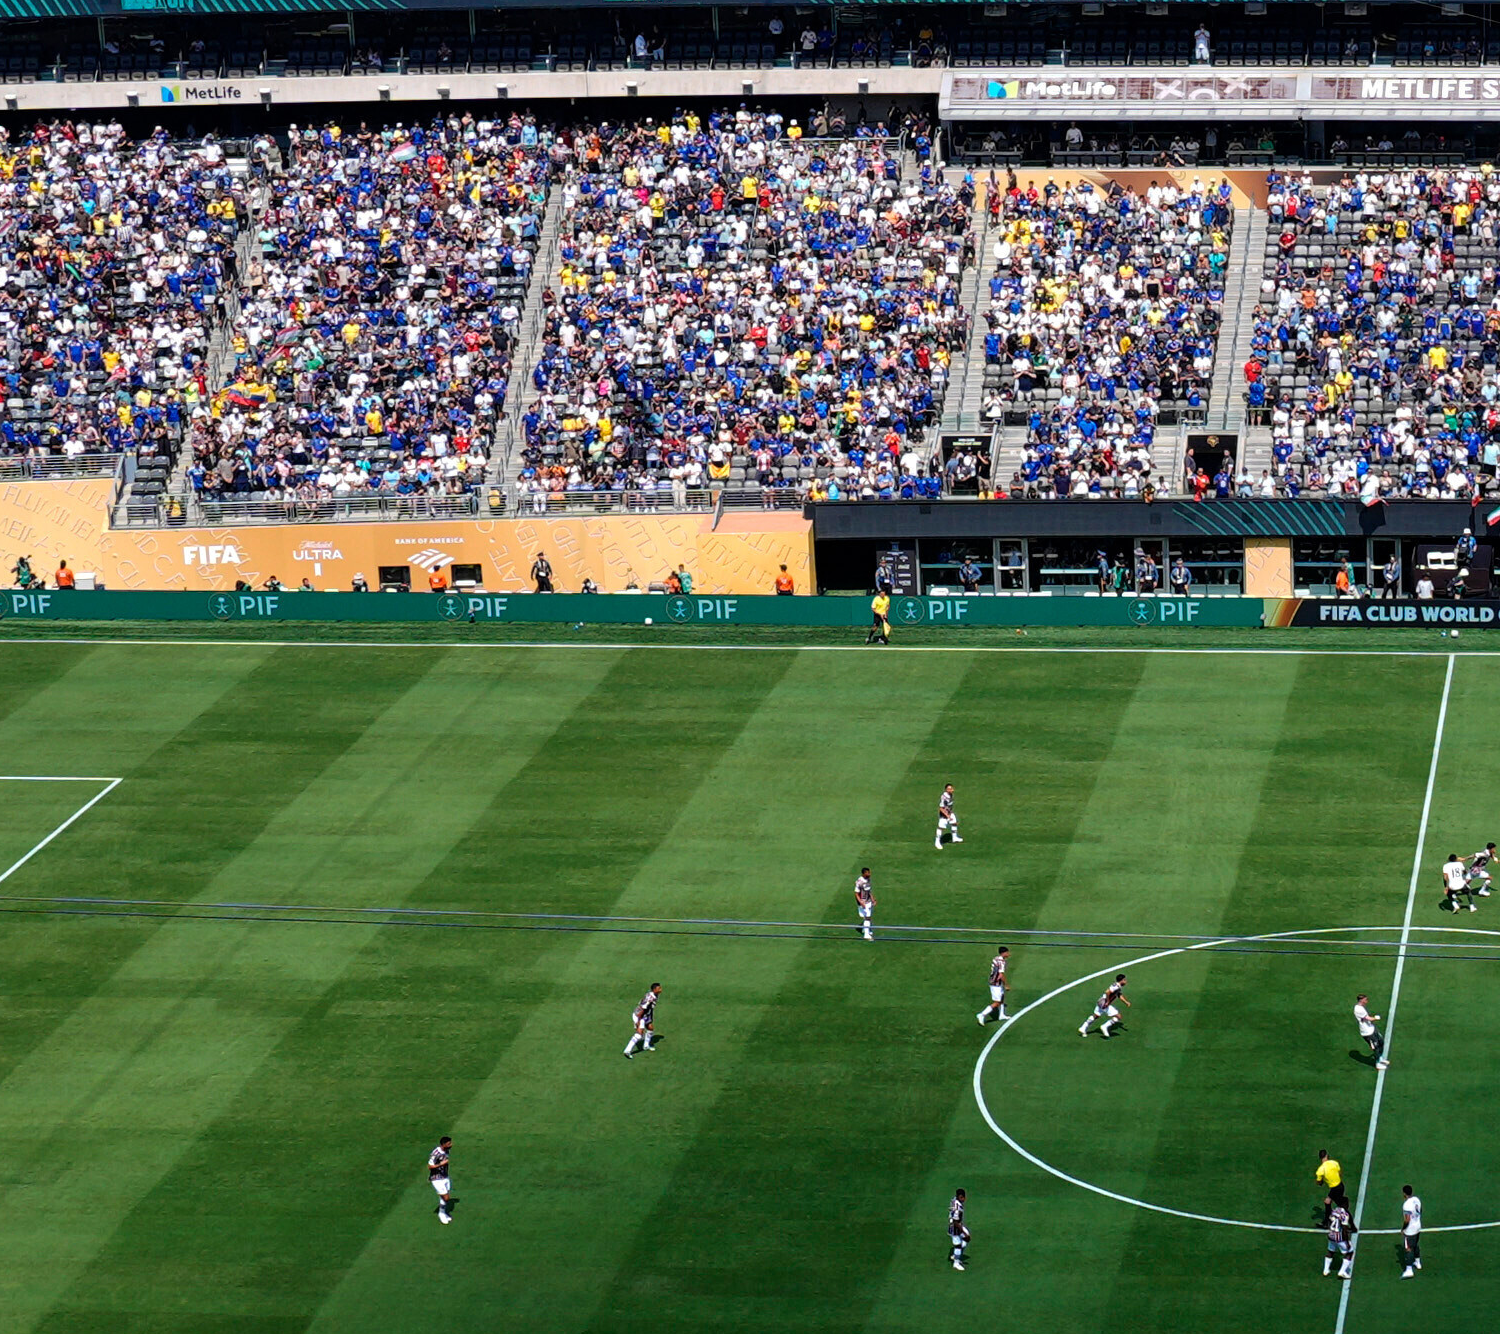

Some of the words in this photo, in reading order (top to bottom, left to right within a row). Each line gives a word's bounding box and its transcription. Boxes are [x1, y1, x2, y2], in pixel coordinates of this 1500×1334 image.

[185, 86, 242, 99] MetLife
[1025, 81, 1117, 96] MetLife
[1362, 79, 1475, 99] METLIFE
[183, 545, 242, 566] FIFA
[293, 549, 344, 561] ULTRA
[12, 594, 51, 614] PIF
[239, 596, 279, 616] PIF
[468, 598, 508, 618] PIF
[698, 599, 738, 619] PIF
[928, 600, 968, 620] PIF
[1160, 602, 1200, 622] PIF
[1320, 605, 1362, 624] FIFA
[1366, 605, 1418, 624] CLUB
[1422, 605, 1494, 625] WORLD
